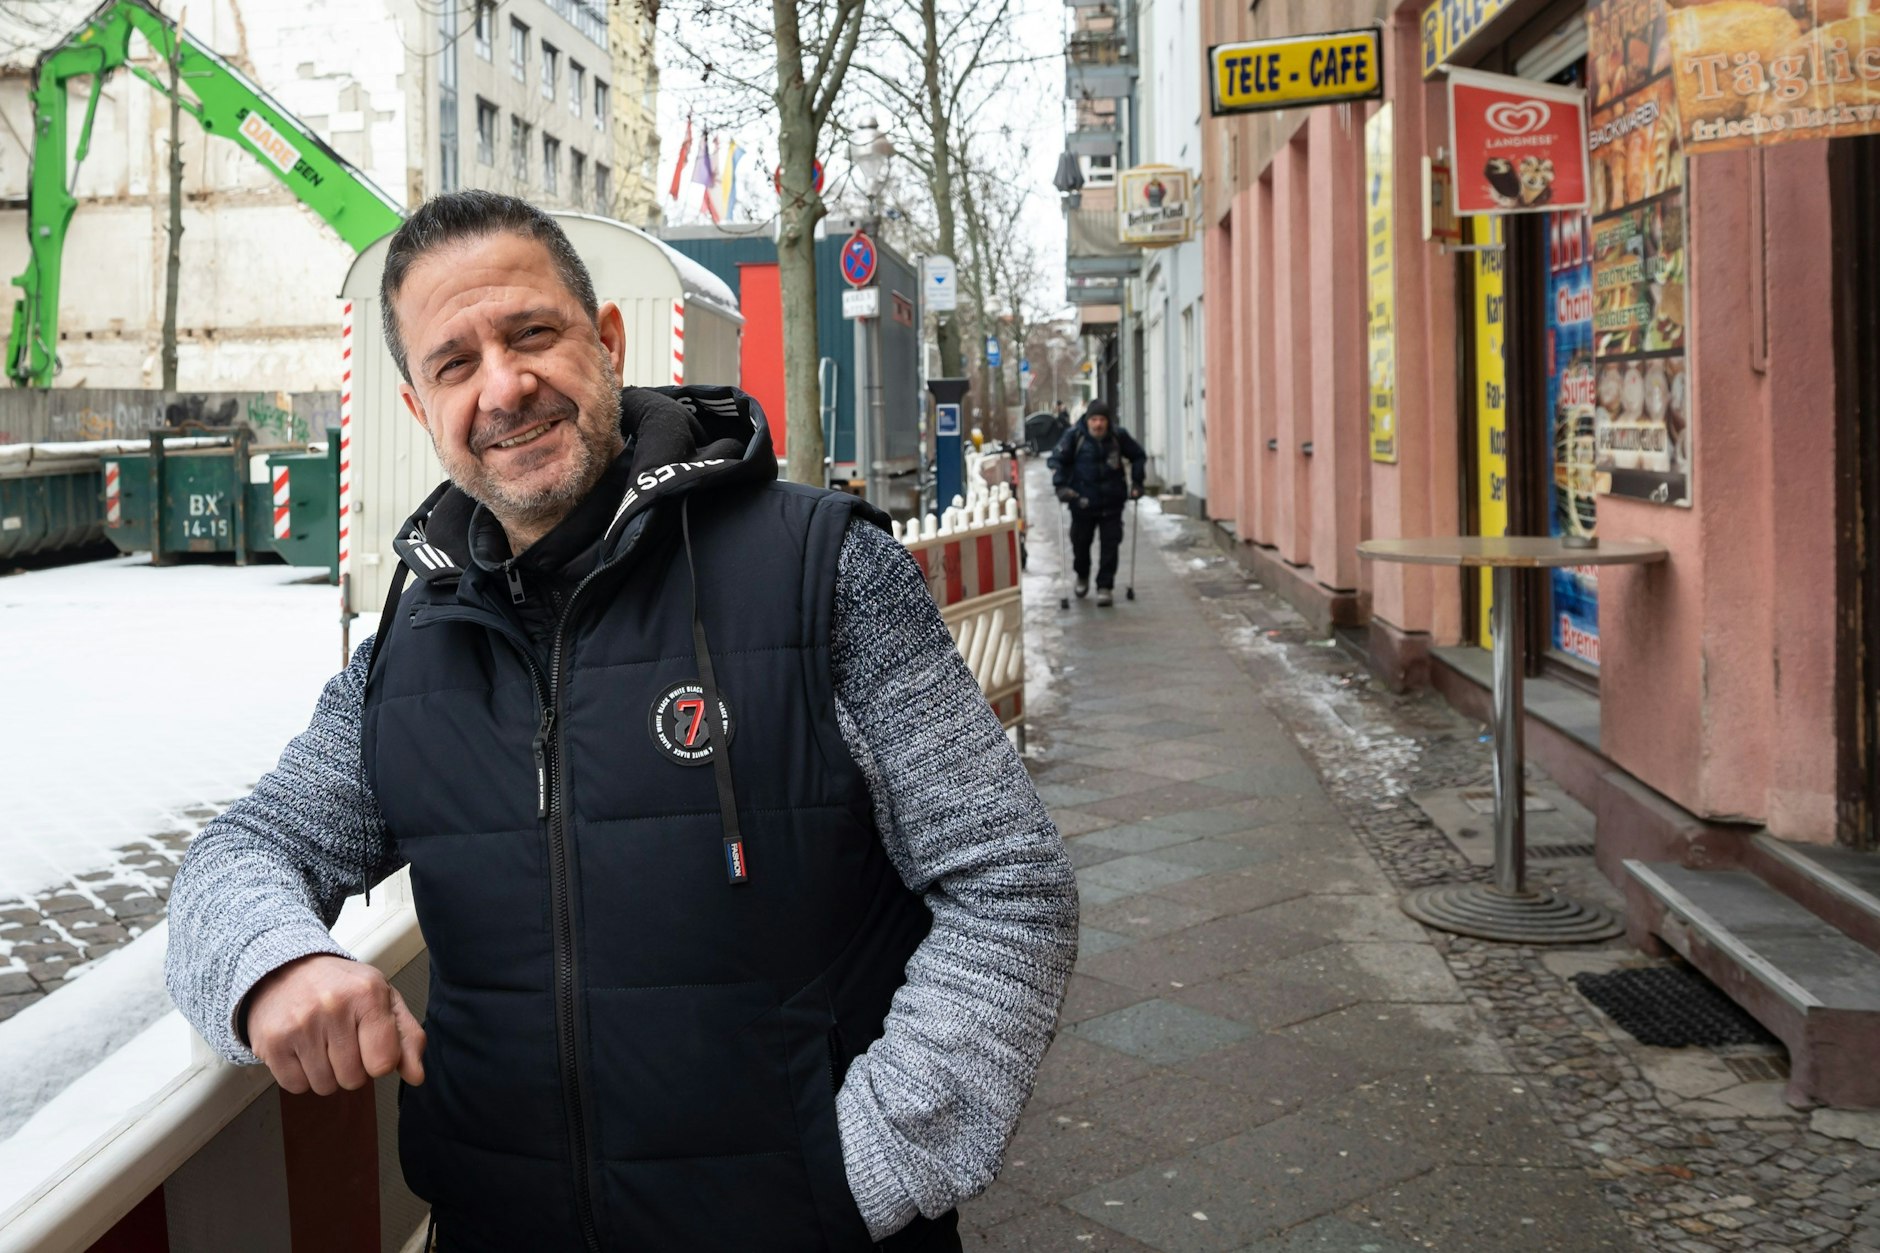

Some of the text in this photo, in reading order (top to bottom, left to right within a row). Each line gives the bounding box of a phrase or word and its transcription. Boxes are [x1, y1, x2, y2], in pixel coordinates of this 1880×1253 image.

[1225, 54, 1281, 96] TELE
[1310, 45, 1368, 87] CAFE
[1589, 101, 1659, 152] BACKWAREN
[1692, 102, 1880, 142] frische Backw
[243, 116, 297, 168] DARE
[1485, 135, 1552, 149] LANGNESE
[190, 494, 219, 516] BX
[668, 686, 686, 700] WHITE
[686, 685, 704, 694] BLACK
[657, 697, 671, 714] BLACK
[655, 714, 663, 733] WHITE
[677, 699, 705, 747] 7
[658, 732, 672, 750] BLACK
[672, 747, 691, 759] BLACK
[730, 842, 742, 877] FASHION
